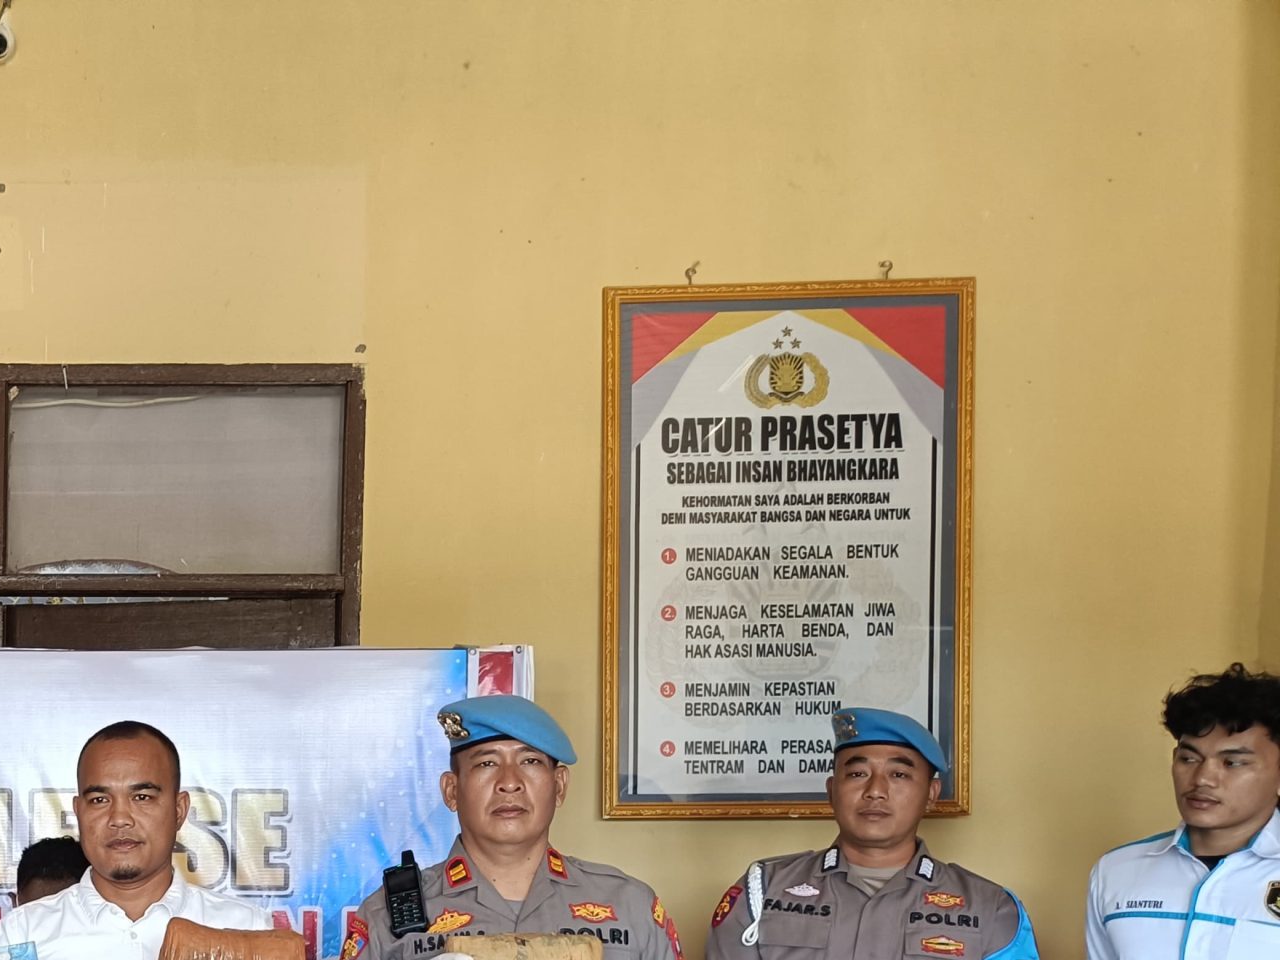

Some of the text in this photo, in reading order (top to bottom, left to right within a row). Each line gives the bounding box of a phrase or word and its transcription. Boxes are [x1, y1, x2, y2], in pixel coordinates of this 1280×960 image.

[661, 413, 903, 454] CATUR PRASETYA
[666, 458, 899, 485] SEBAGAI INSAN BHAYANGKARA
[681, 492, 891, 508] KEHORMATAN SAYA ADALAH BERKORBAN
[661, 508, 911, 525] DEMI MASYARAKAT BANGSA DAN NEGARA UNTUK
[685, 546, 770, 562] MENIADAKAN
[780, 545, 834, 561] SEGALA
[846, 544, 899, 559] BENTUK
[685, 564, 849, 582] GANGGUAN KEAMANAN.
[685, 605, 748, 620] MENJAGA
[760, 603, 854, 619] KESELAMATAN
[864, 602, 896, 618] JIWA
[685, 622, 894, 642] RAGA, HARTA BENDA, DAN
[684, 642, 817, 659] HAK ASASI MANUSIA.
[684, 682, 750, 698] MENJAMIN
[764, 681, 835, 697] KEPASTIAN
[684, 700, 842, 717] BERDASARKAN HUKUM
[684, 740, 768, 756] MEMELIHARA
[780, 739, 834, 755] PERASA
[684, 758, 835, 775] TENTRAM DAN DAMA
[909, 911, 979, 929] POLRI
